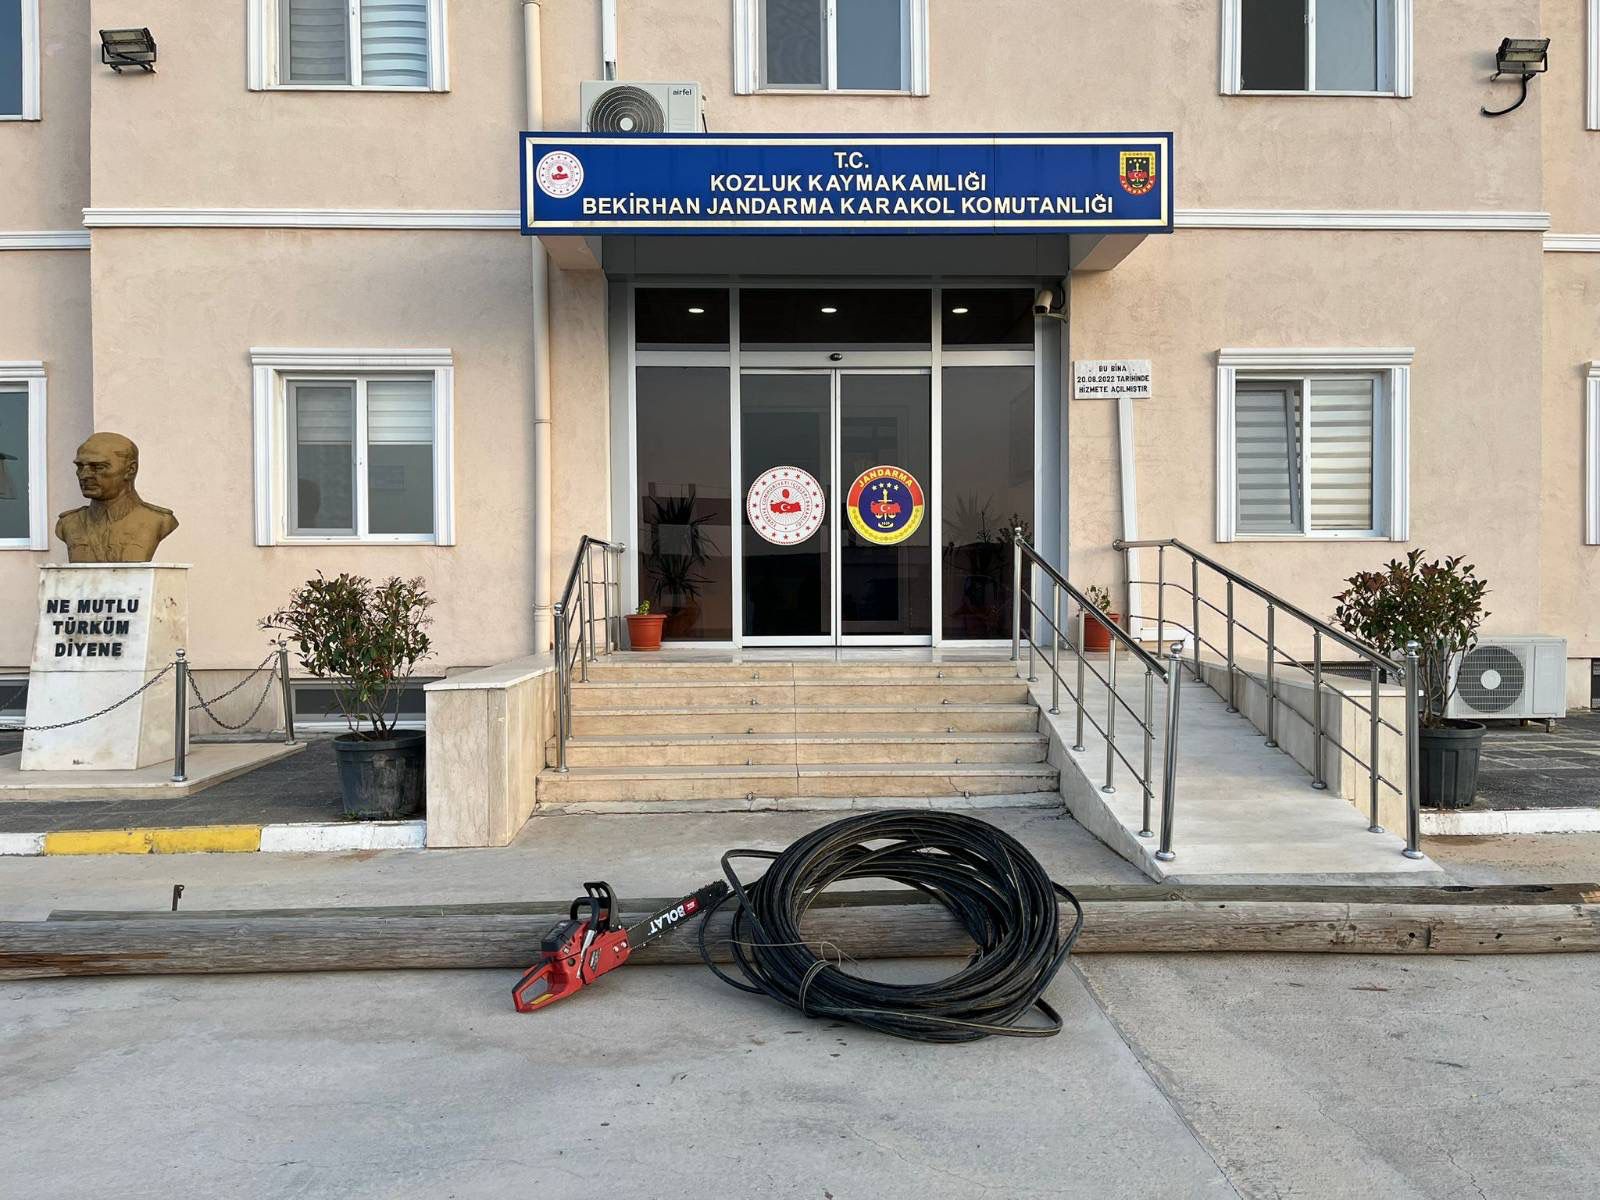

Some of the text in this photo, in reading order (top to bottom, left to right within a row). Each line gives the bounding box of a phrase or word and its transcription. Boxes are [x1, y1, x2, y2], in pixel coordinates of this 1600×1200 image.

[672, 88, 692, 96] airfel
[833, 151, 870, 169] T.C.
[710, 171, 987, 192] KOZLUK KAYMAKAMLIĞI
[582, 192, 1113, 215] BEKİRHAN JANDARMA KARAKOL KOMUTANLIĞI
[1110, 363, 1127, 372] BİNA
[1116, 374, 1150, 382] TARİHİNDE
[1078, 384, 1109, 393] HİZMETE
[858, 468, 913, 488] JANDARMA
[46, 599, 140, 614] NE MUTLU
[52, 616, 130, 635] TÜRKÜM
[54, 638, 122, 657] DİYENE
[650, 904, 686, 934] BOLAT
